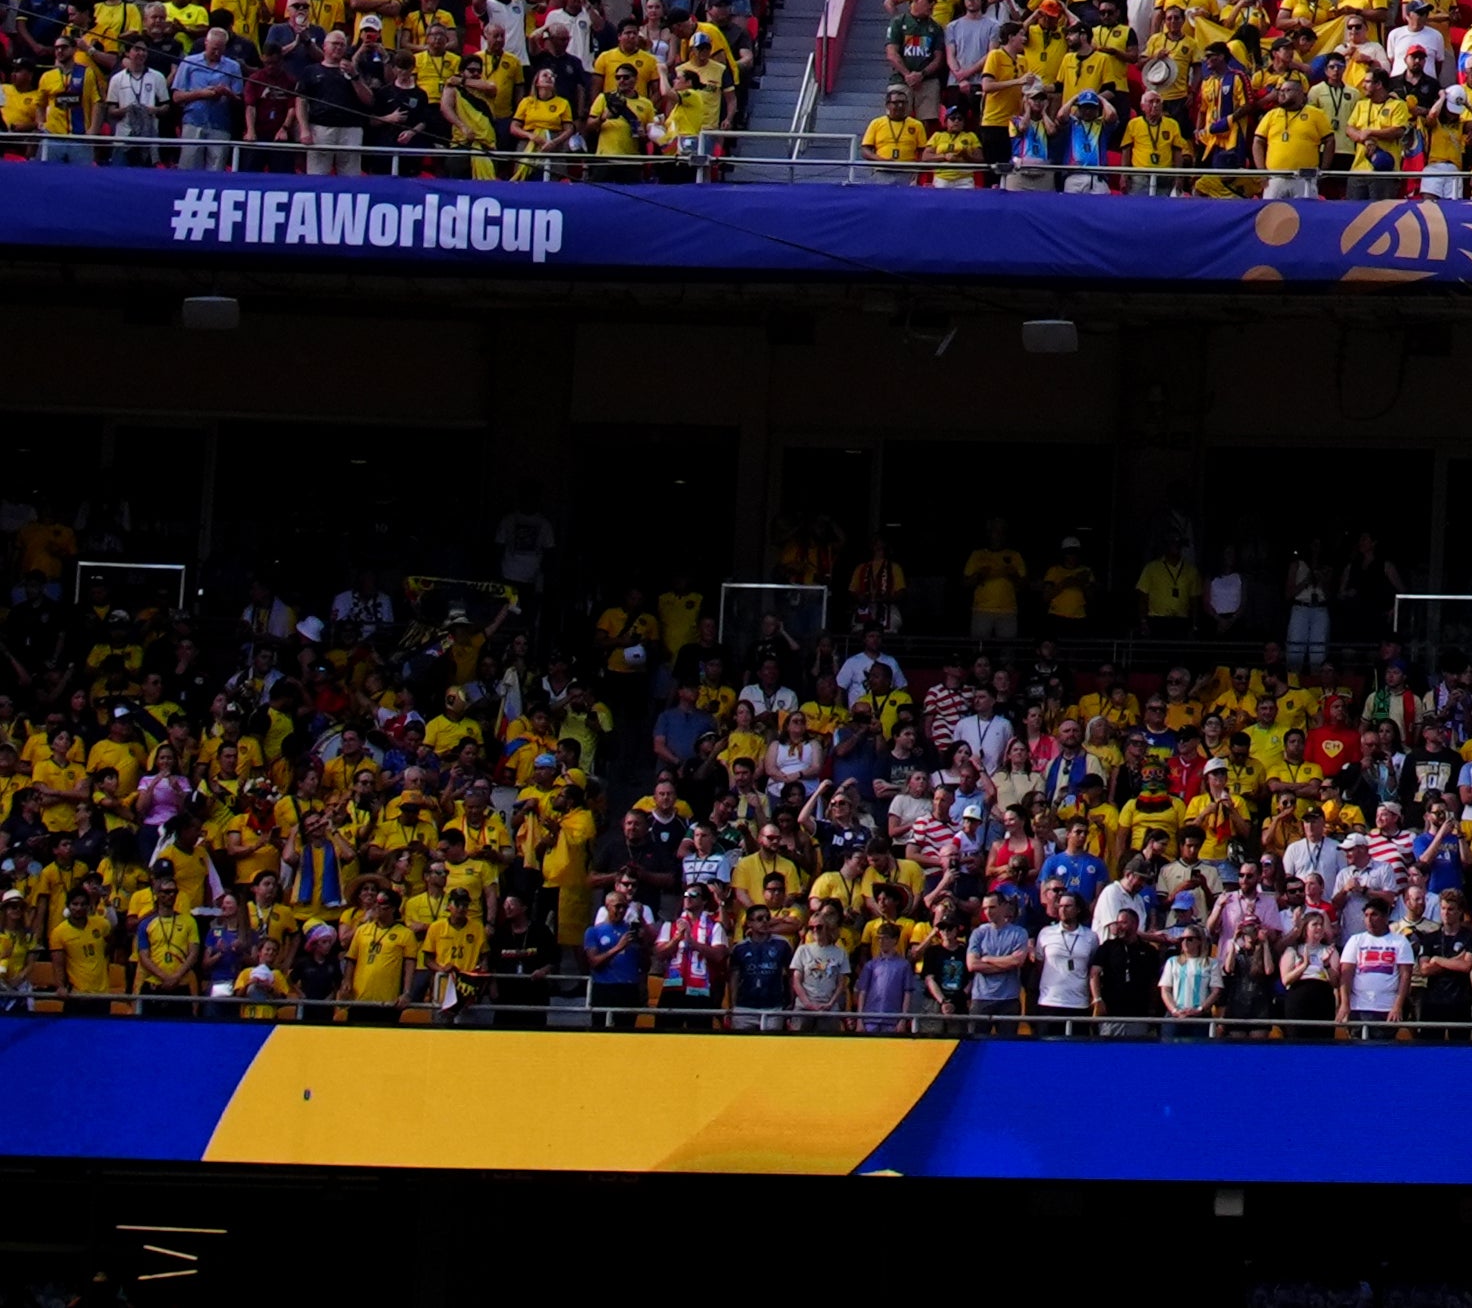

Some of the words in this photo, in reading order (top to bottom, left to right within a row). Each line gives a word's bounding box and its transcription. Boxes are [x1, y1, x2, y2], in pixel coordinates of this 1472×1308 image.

[171, 188, 563, 260] #FIFAWorldCup
[1323, 742, 1340, 751] CH
[832, 834, 844, 847] 10
